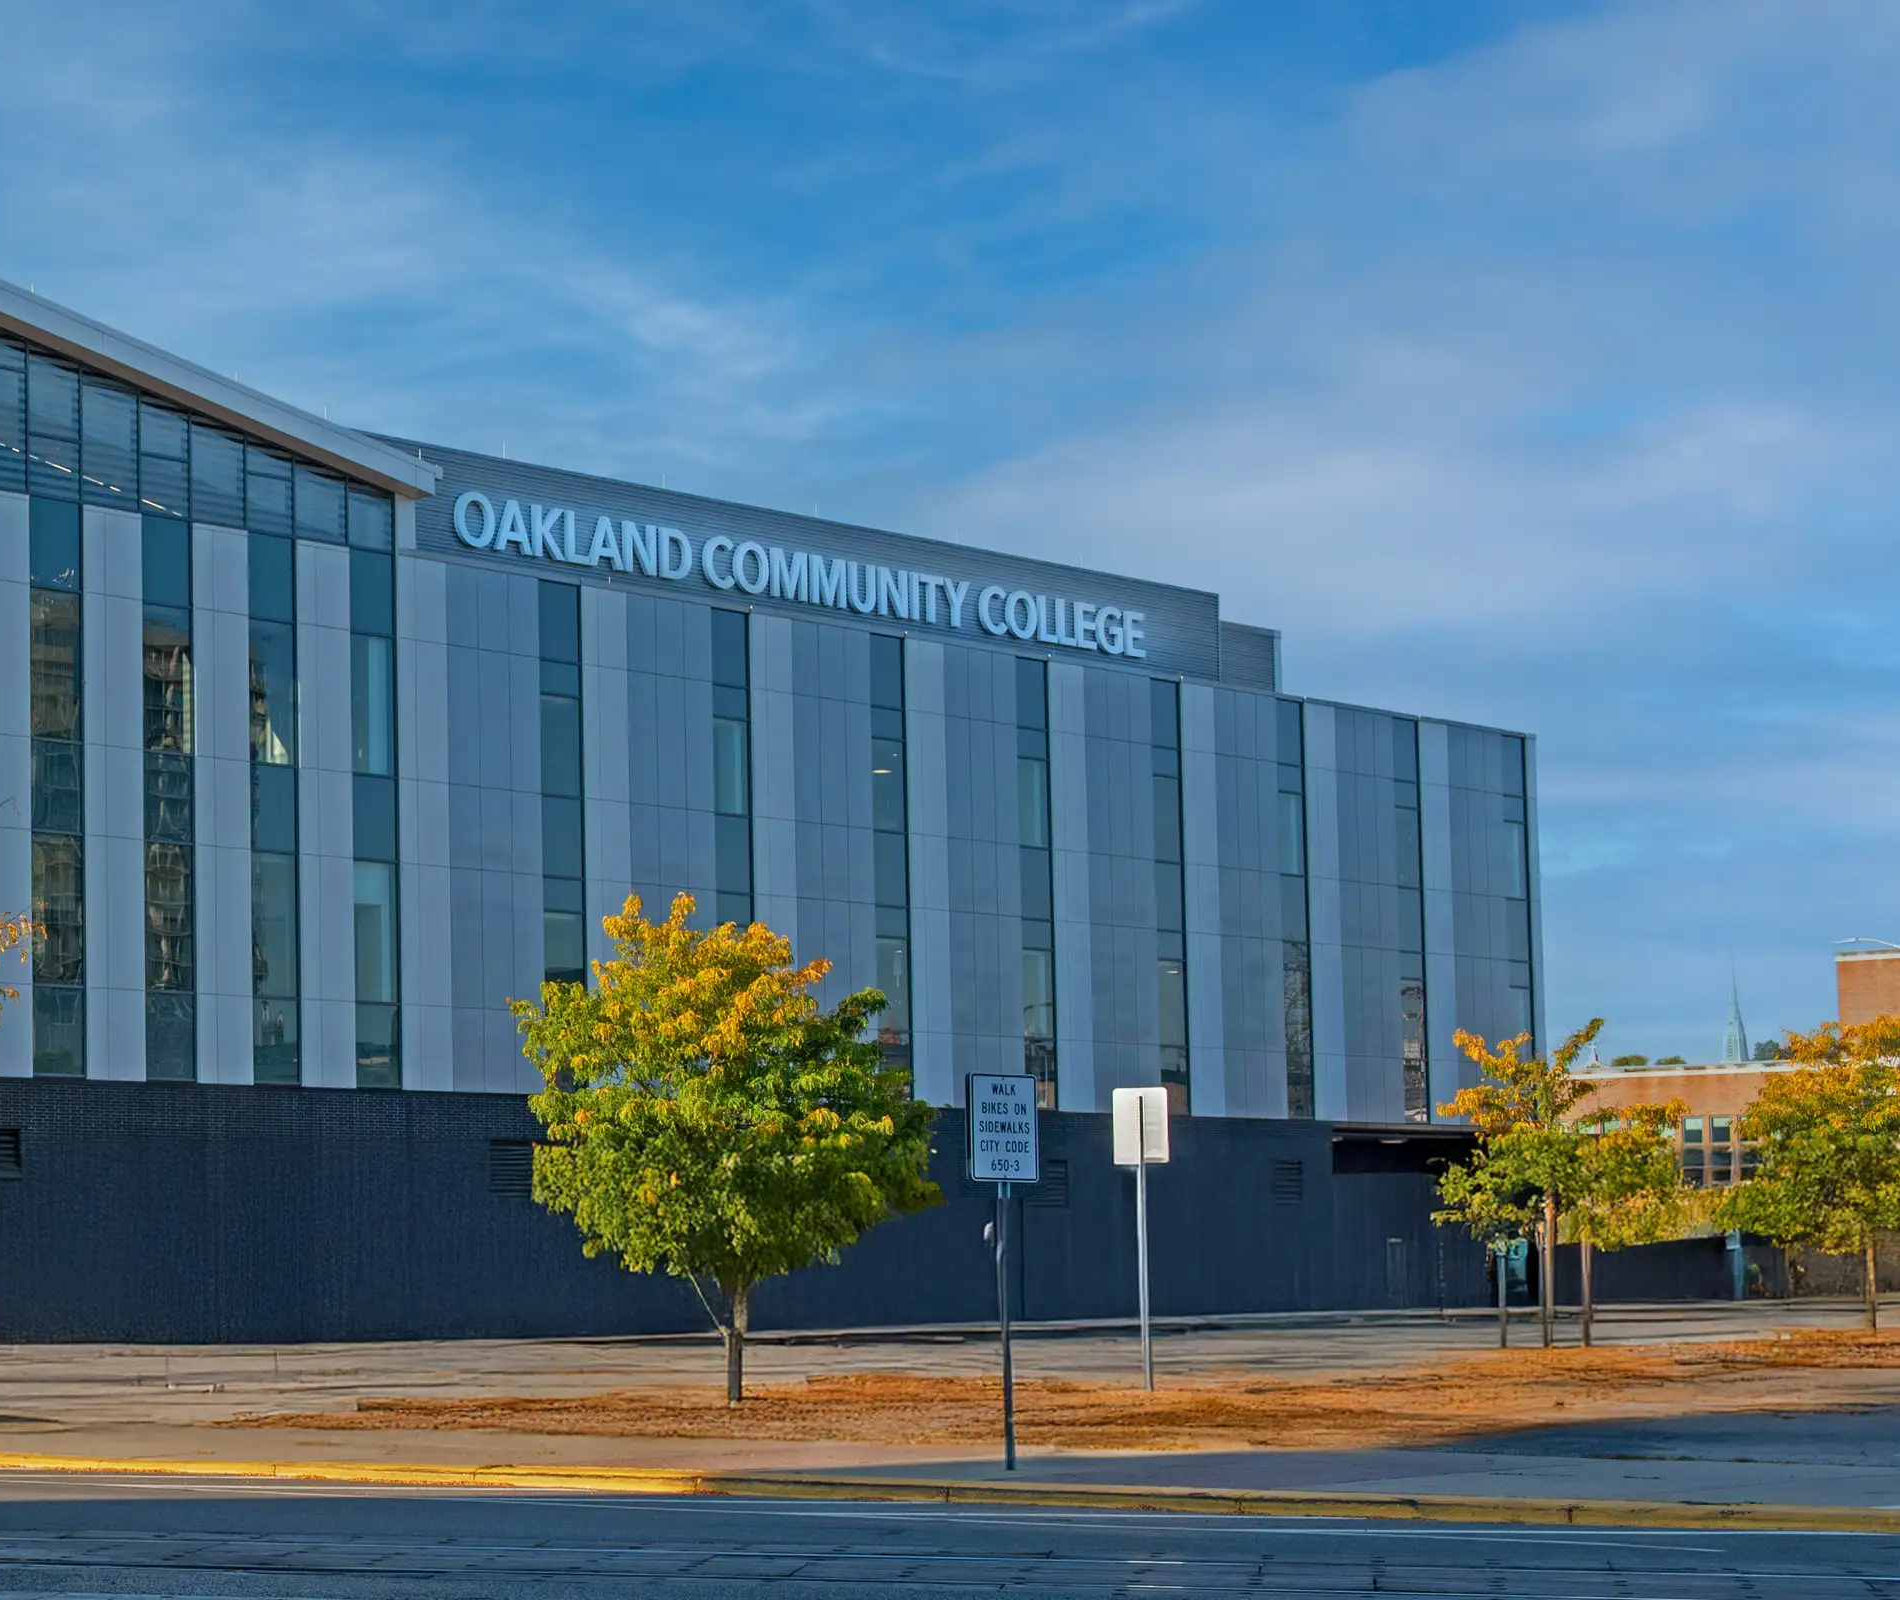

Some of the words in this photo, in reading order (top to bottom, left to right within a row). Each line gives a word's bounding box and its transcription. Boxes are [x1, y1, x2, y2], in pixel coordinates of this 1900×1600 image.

[453, 491, 693, 580] OAKLAND
[702, 536, 971, 628] COMMUNITY
[978, 586, 1146, 658] COLLEGE
[991, 1083, 1016, 1096] WALK
[981, 1101, 1009, 1115] BIKES
[1014, 1103, 1027, 1116] ON
[978, 1120, 1030, 1135] SIDEWALKS
[980, 1140, 1000, 1152] CITY
[1005, 1140, 1030, 1153] CODE
[991, 1159, 1020, 1172] 650-3
